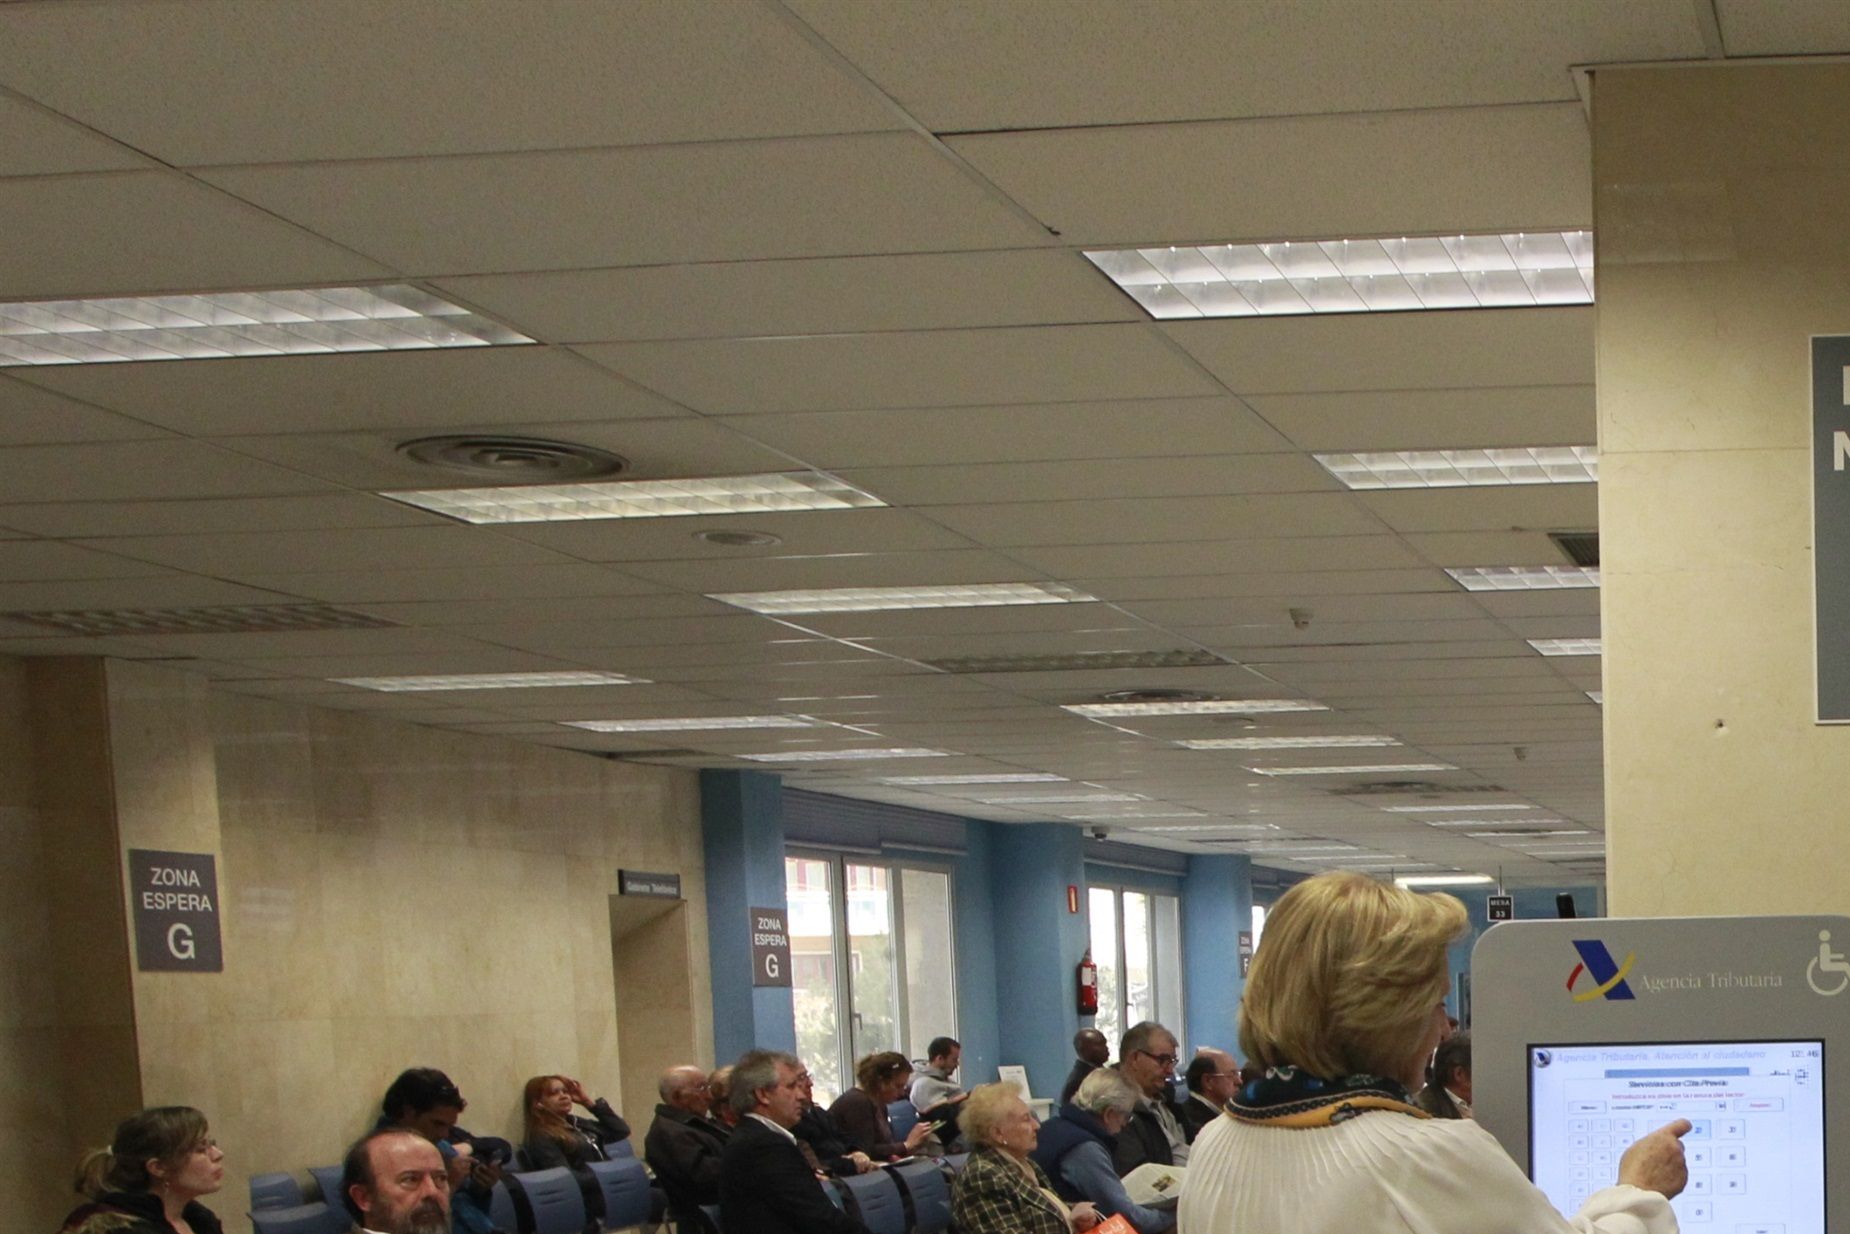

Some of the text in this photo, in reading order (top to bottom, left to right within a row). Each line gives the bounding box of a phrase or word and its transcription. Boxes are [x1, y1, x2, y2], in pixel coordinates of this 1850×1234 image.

[150, 867, 201, 887] ZONA
[142, 892, 213, 912] ESPERA
[757, 917, 782, 931] ZONA
[167, 922, 196, 960] G
[754, 933, 787, 946] ESPERA
[765, 953, 779, 978] G
[1640, 971, 1783, 993] Agencia Tributaria
